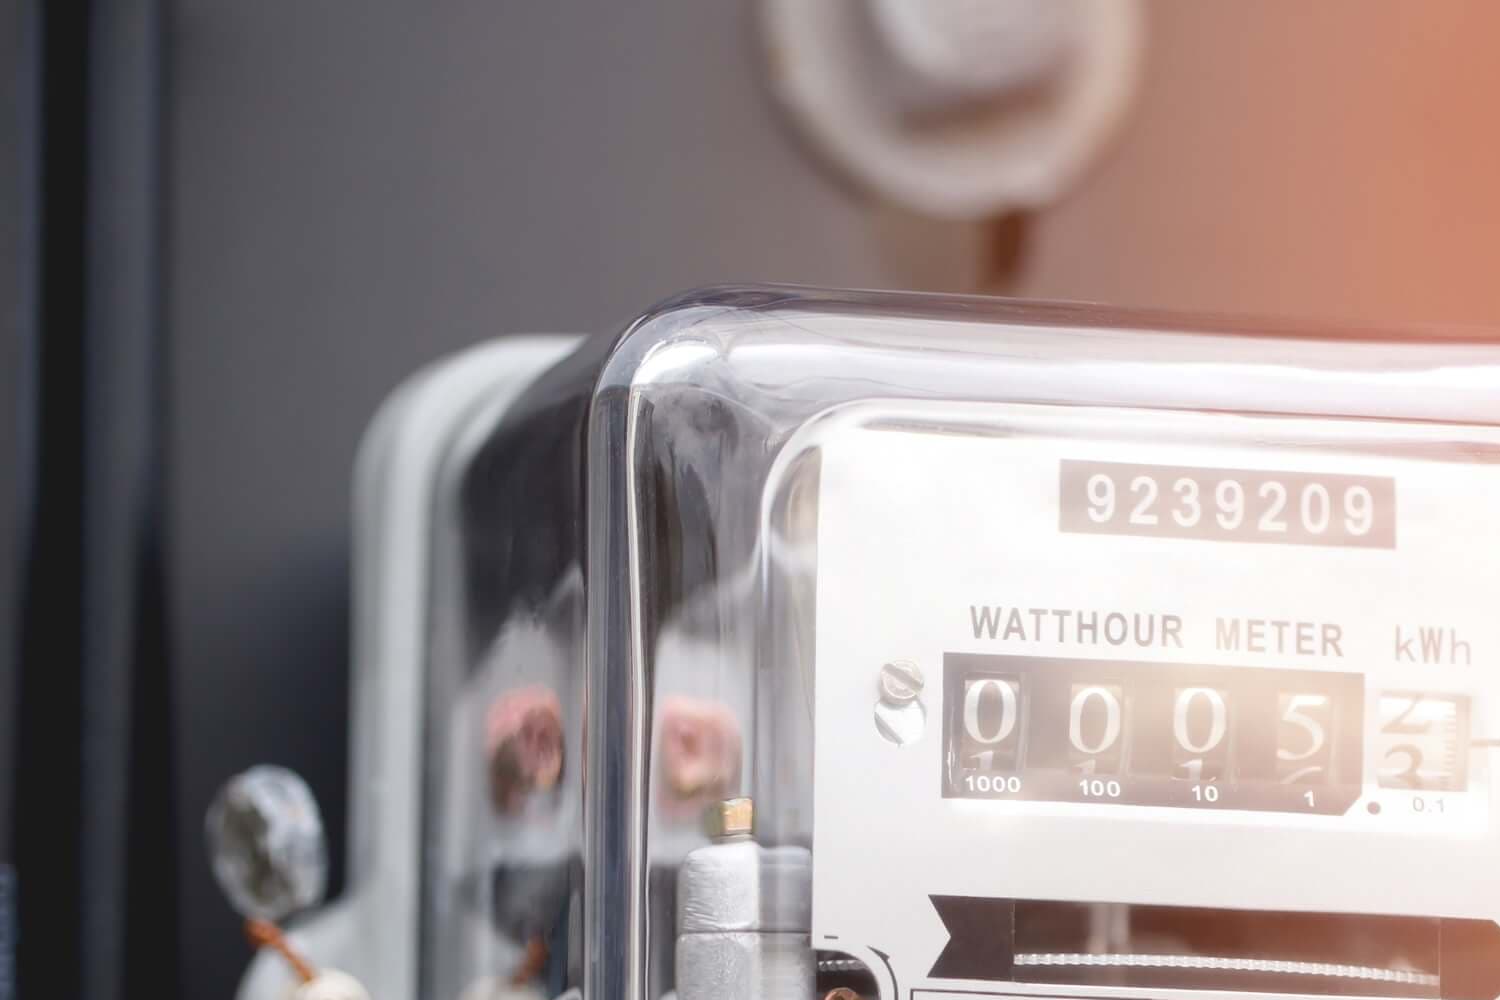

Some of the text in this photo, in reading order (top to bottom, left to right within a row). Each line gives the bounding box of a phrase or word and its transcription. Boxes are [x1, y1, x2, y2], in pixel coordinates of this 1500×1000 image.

[1087, 474, 1373, 535] 9239209
[970, 605, 1472, 666] WATTHOUR METER kWh
[965, 776, 1445, 813] 1000 100 10 1 0.1
